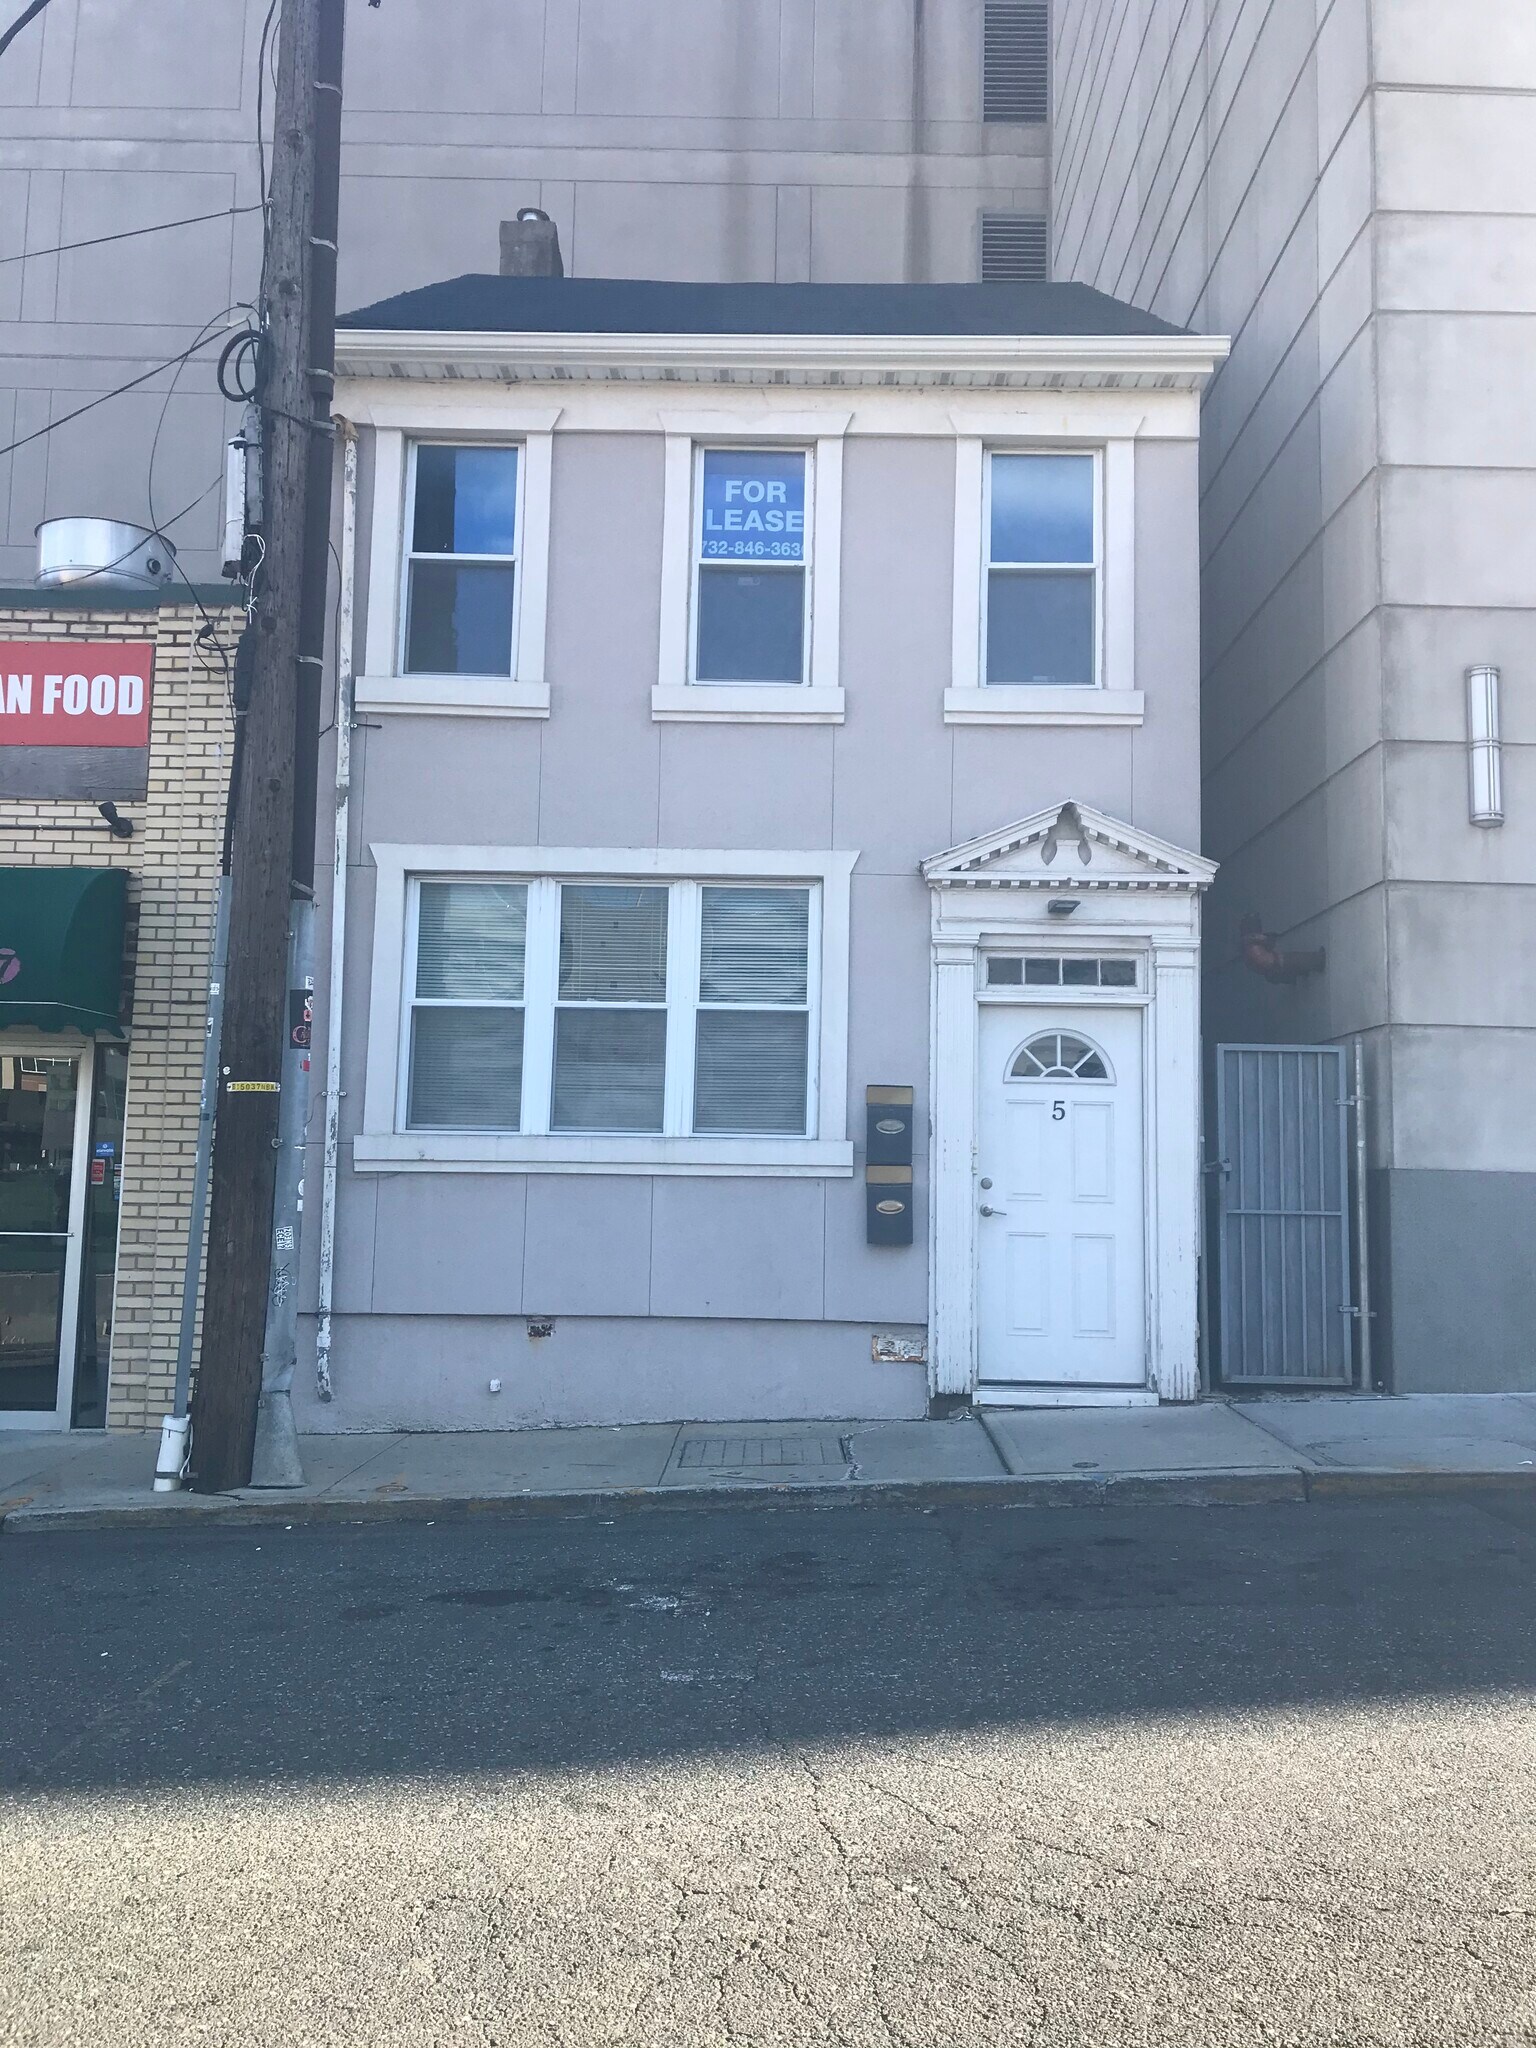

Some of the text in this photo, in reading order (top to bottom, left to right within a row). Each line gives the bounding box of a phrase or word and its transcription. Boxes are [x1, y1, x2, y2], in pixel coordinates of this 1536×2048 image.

[725, 480, 787, 503] FOR
[706, 509, 804, 532] LEASE
[702, 540, 804, 556] 732-846-363
[0, 674, 144, 716] N FOOD
[1052, 1100, 1066, 1121] 5
